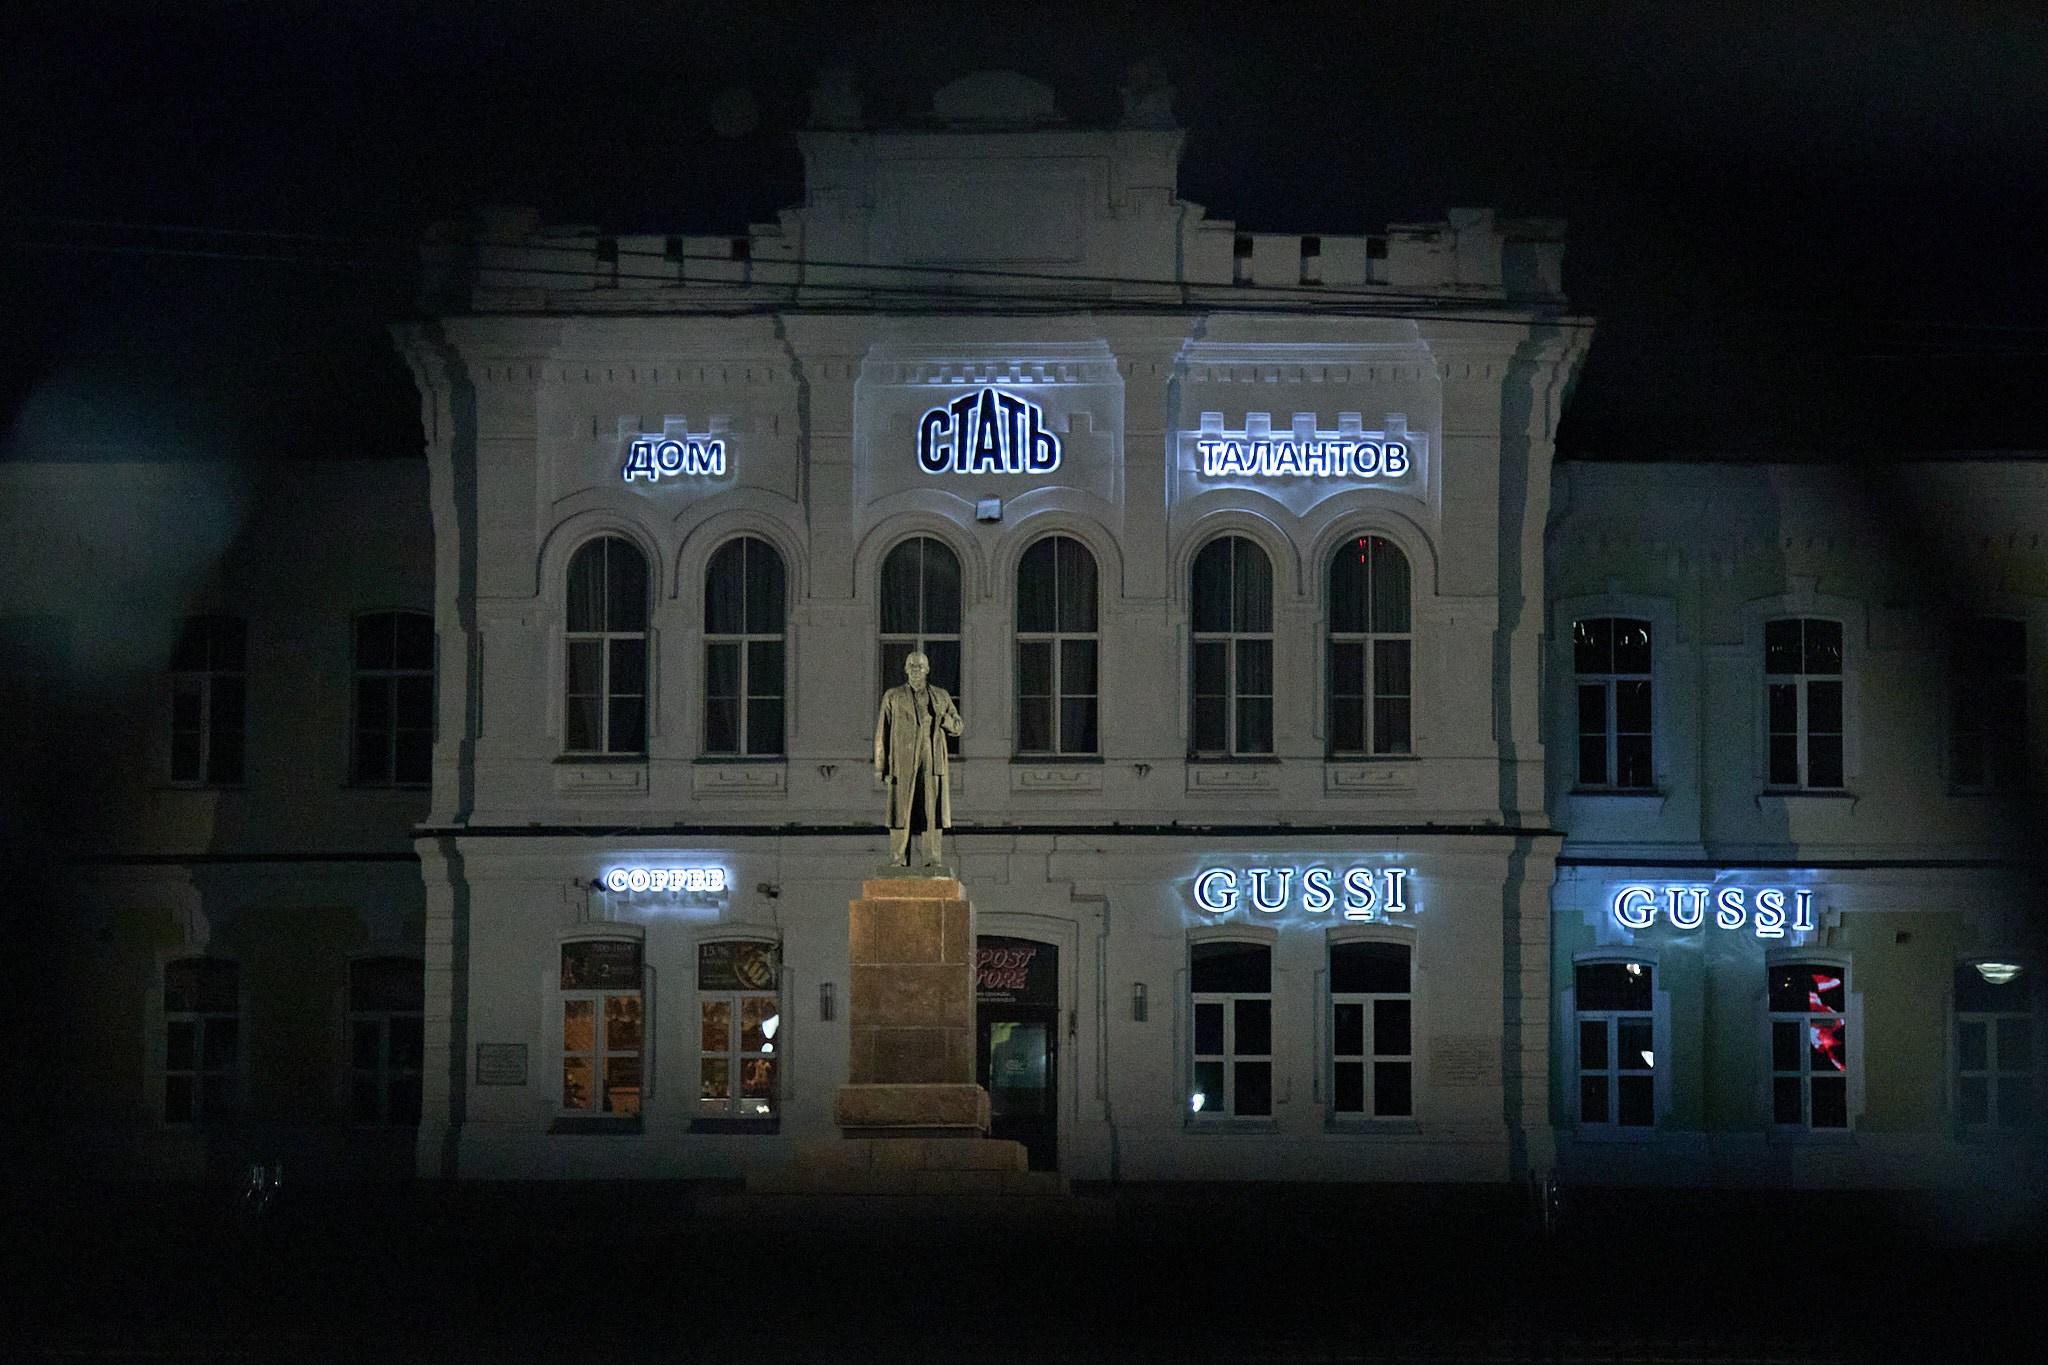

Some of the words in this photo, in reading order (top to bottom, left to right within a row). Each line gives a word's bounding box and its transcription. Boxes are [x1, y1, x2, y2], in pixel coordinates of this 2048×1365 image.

[918, 386, 1062, 475] СТАТЬ
[623, 440, 726, 482] ДОМ
[1197, 440, 1410, 478] ТАЛАНТОВ
[607, 868, 726, 892] COFFEE
[1194, 867, 1407, 920] GUSSI
[1613, 883, 1814, 938] GUSSI
